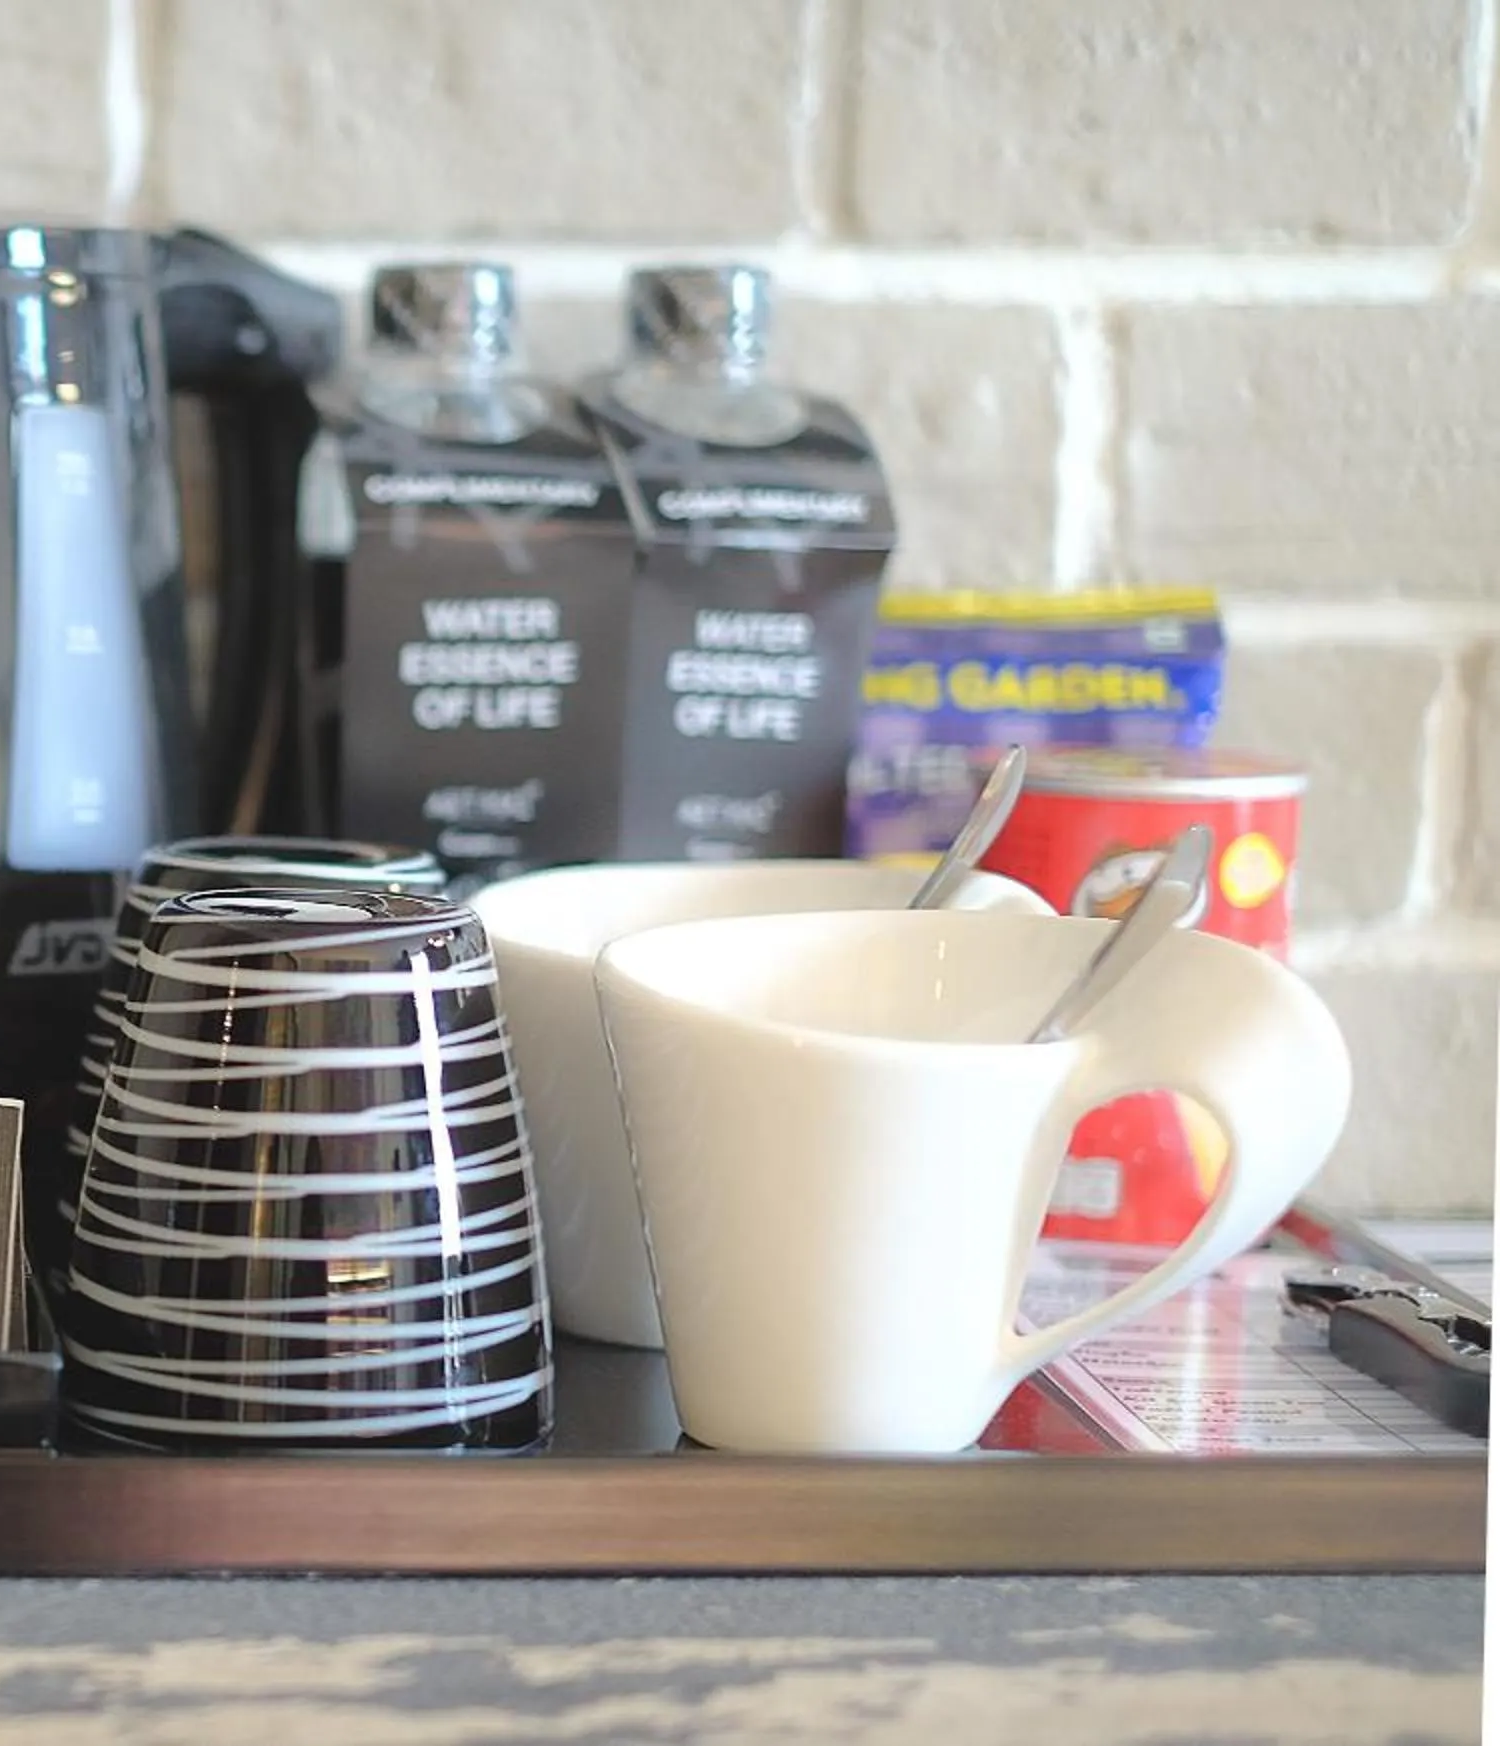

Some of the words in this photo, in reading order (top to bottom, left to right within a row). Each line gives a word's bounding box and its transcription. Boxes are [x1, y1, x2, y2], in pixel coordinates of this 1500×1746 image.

[422, 598, 559, 639] WATER
[695, 611, 812, 650] WATER
[401, 642, 579, 684] ESSENCE
[667, 652, 820, 697] ESSENCE
[413, 687, 471, 730] OF
[474, 687, 560, 728] LIFE
[673, 697, 724, 737] OF
[726, 698, 800, 740] LIFE
